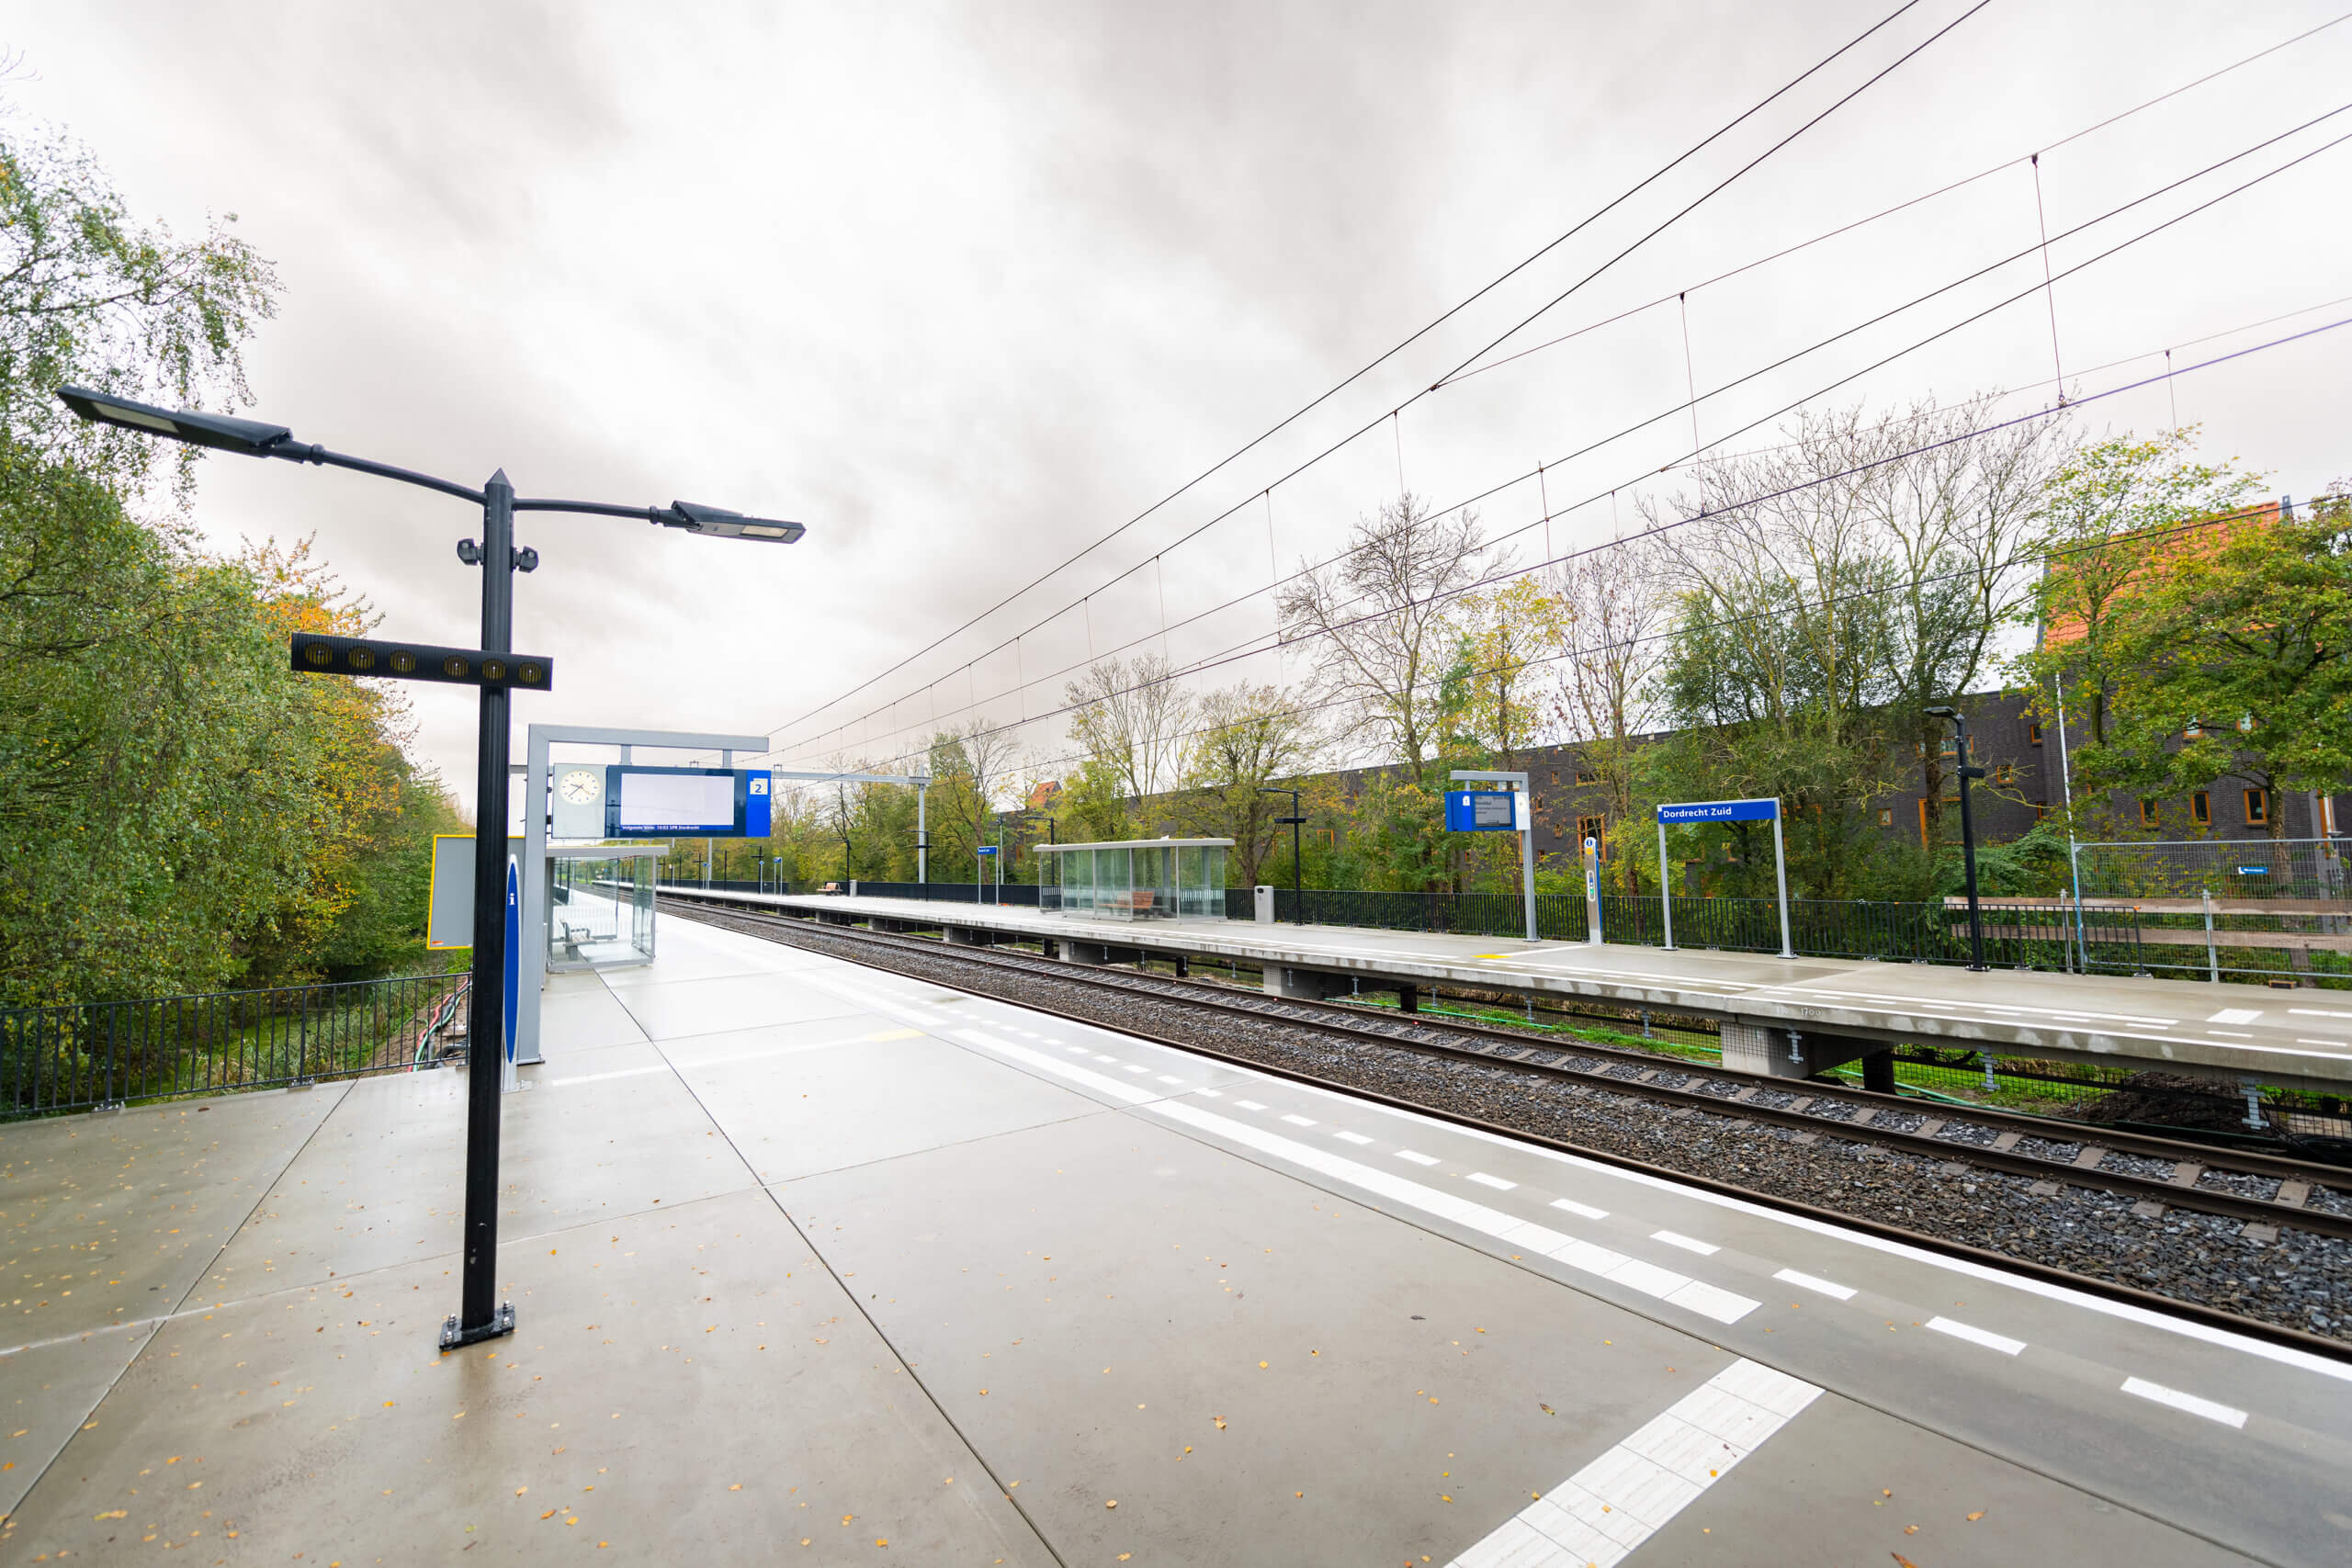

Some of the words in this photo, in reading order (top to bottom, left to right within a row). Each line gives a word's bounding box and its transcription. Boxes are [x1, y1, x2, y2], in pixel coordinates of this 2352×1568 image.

[755, 784, 762, 794] 2
[1663, 808, 1708, 818] Dordrecht
[1711, 807, 1732, 816] Zuid
